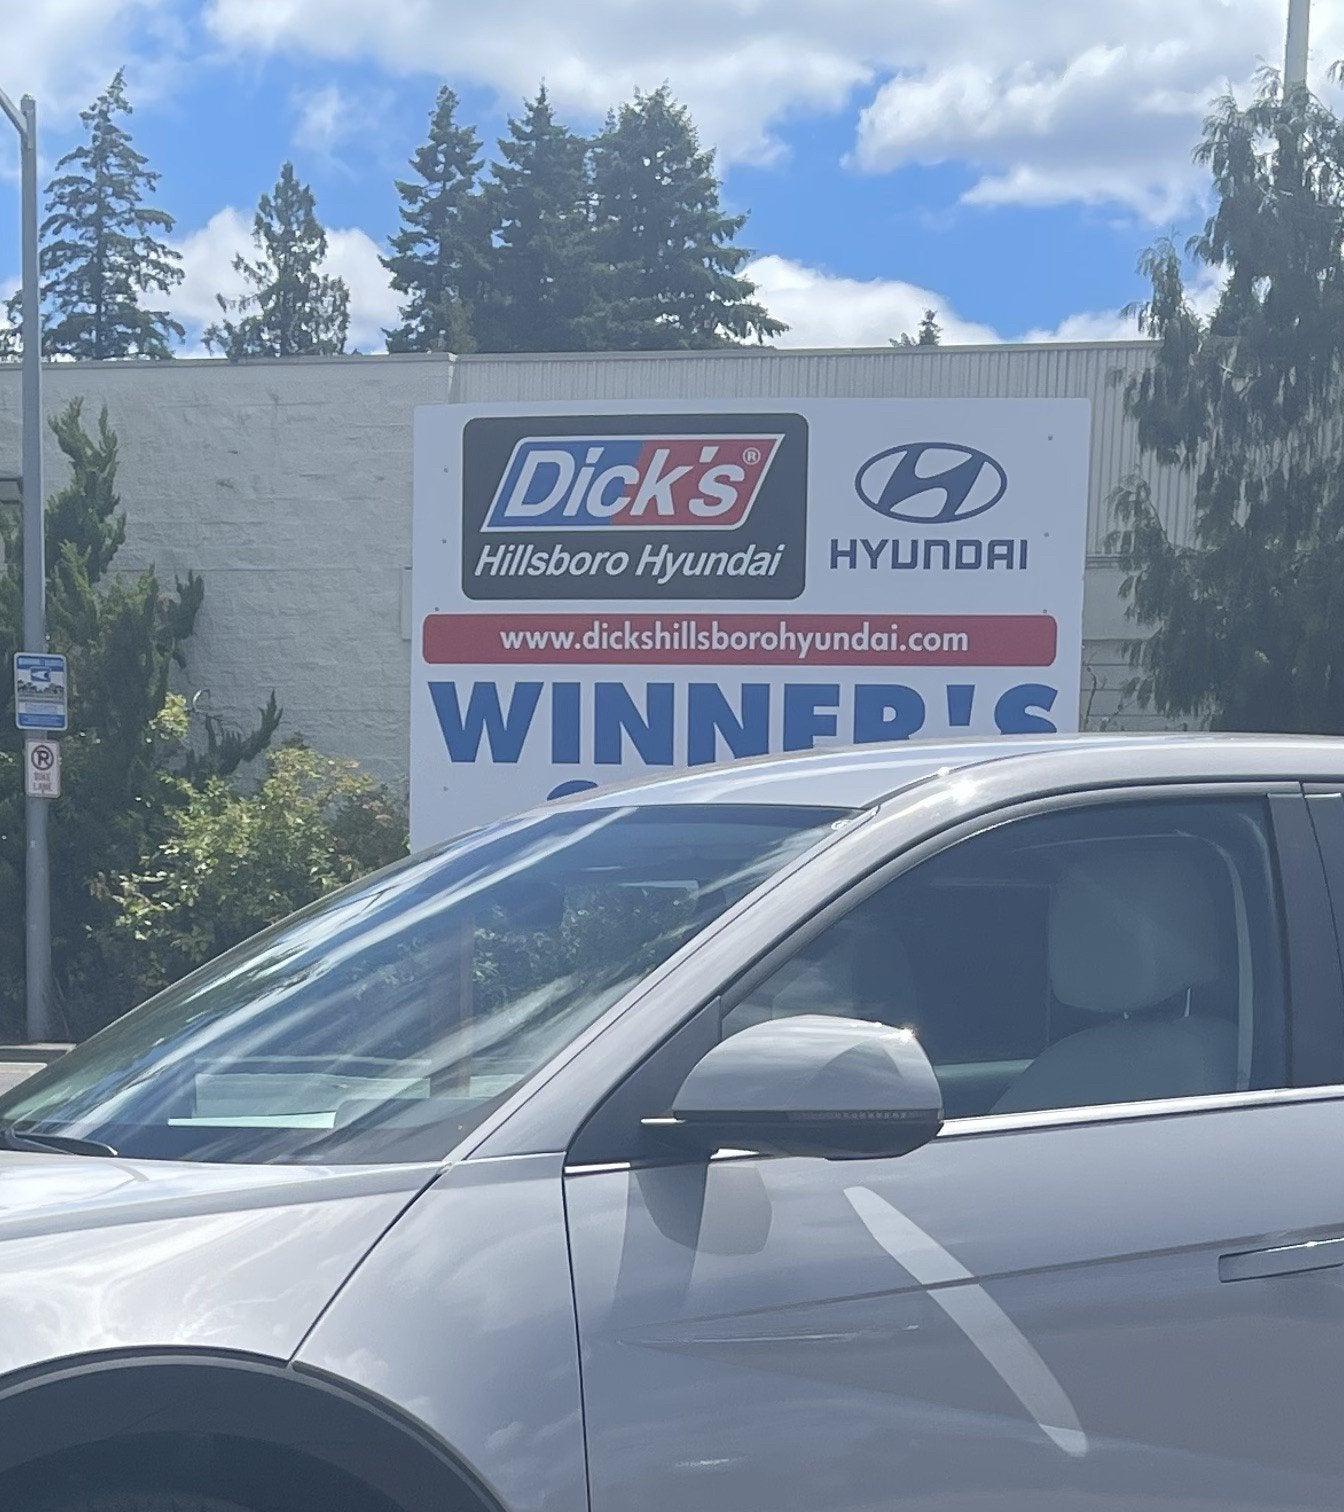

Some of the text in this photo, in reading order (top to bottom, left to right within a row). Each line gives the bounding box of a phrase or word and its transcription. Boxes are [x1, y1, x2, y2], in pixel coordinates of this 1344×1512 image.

[504, 446, 744, 517] Dick's
[474, 544, 786, 584] Hillsboro Hyundai
[831, 539, 1028, 570] HYUNDAI
[500, 621, 968, 658] www.dickshillsborohyundai.com
[427, 681, 1059, 766] WINNER'S
